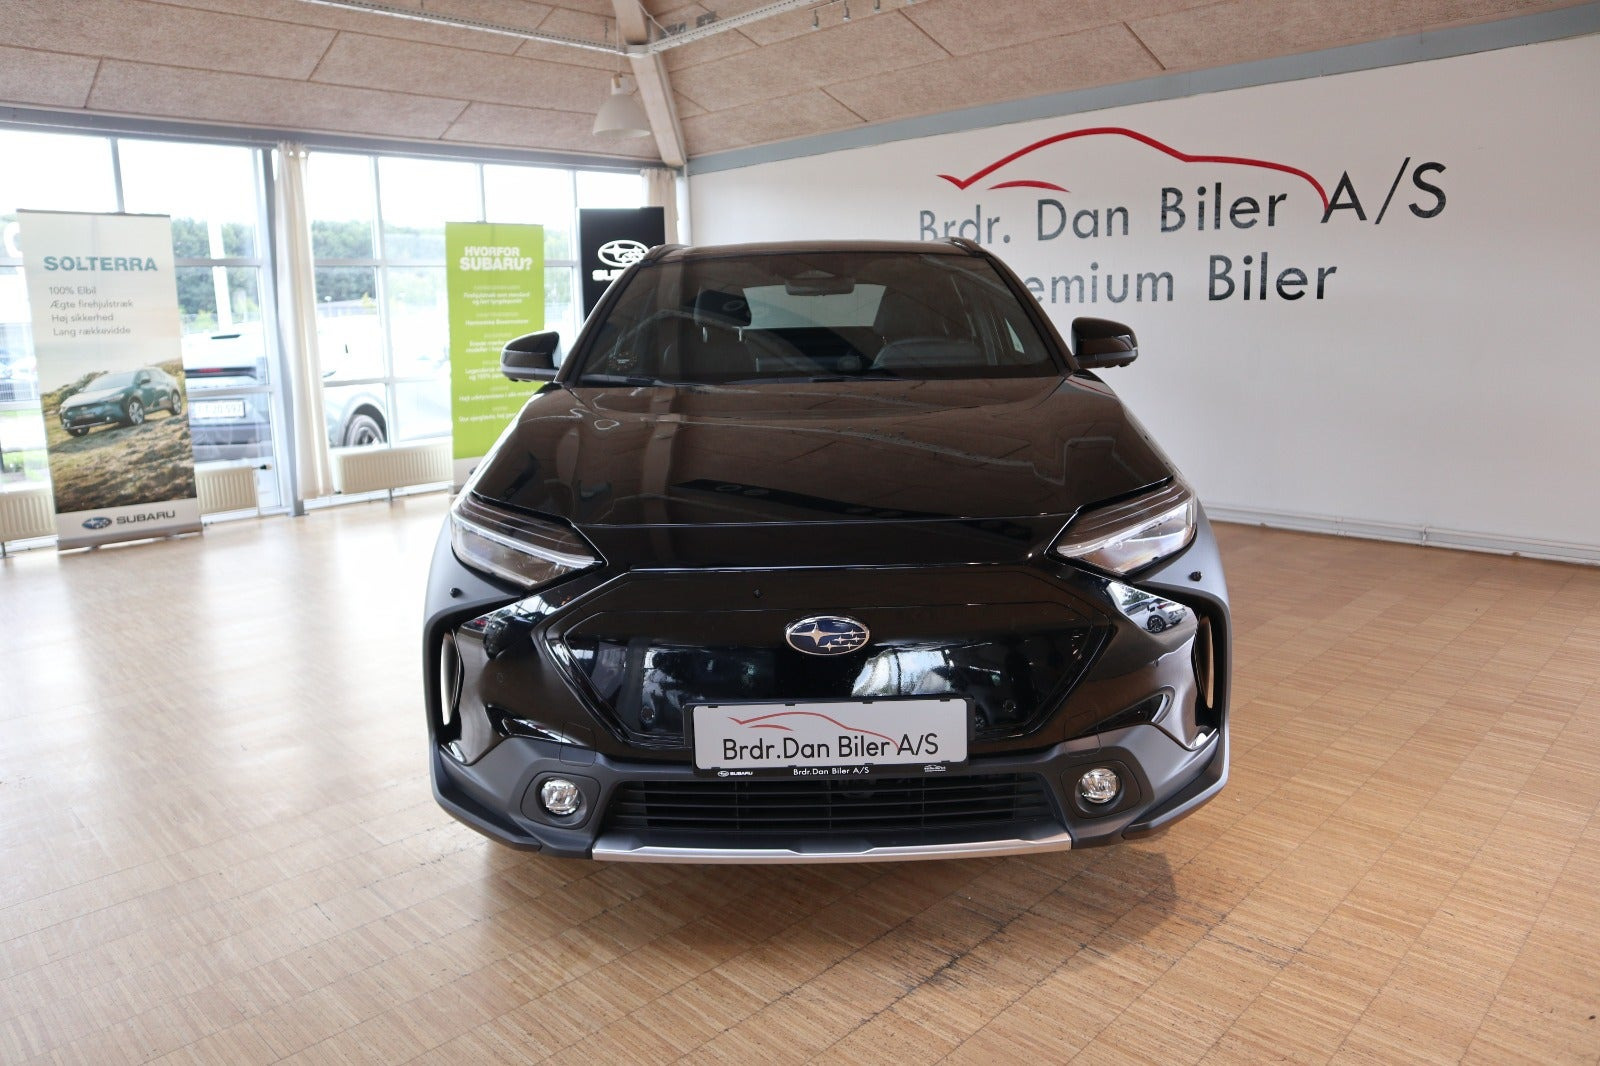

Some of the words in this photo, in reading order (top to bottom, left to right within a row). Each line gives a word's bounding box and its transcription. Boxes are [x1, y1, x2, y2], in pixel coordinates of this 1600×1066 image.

[919, 204, 1011, 244] Brdr.
[1037, 198, 1129, 241] Dan
[1160, 181, 1288, 233] Biler
[1320, 156, 1447, 226] A/S
[464, 246, 520, 257] HVORFOR
[43, 256, 158, 271] SOLTERRA
[459, 257, 533, 271] SUBARU?
[1023, 261, 1174, 304] emium
[1208, 251, 1338, 301] Biler
[49, 286, 74, 295] 100%
[116, 510, 176, 524] SUBARU
[838, 735, 890, 757] Biler
[897, 733, 938, 755] A/S
[831, 767, 850, 775] Biler
[852, 766, 870, 774] A/S
